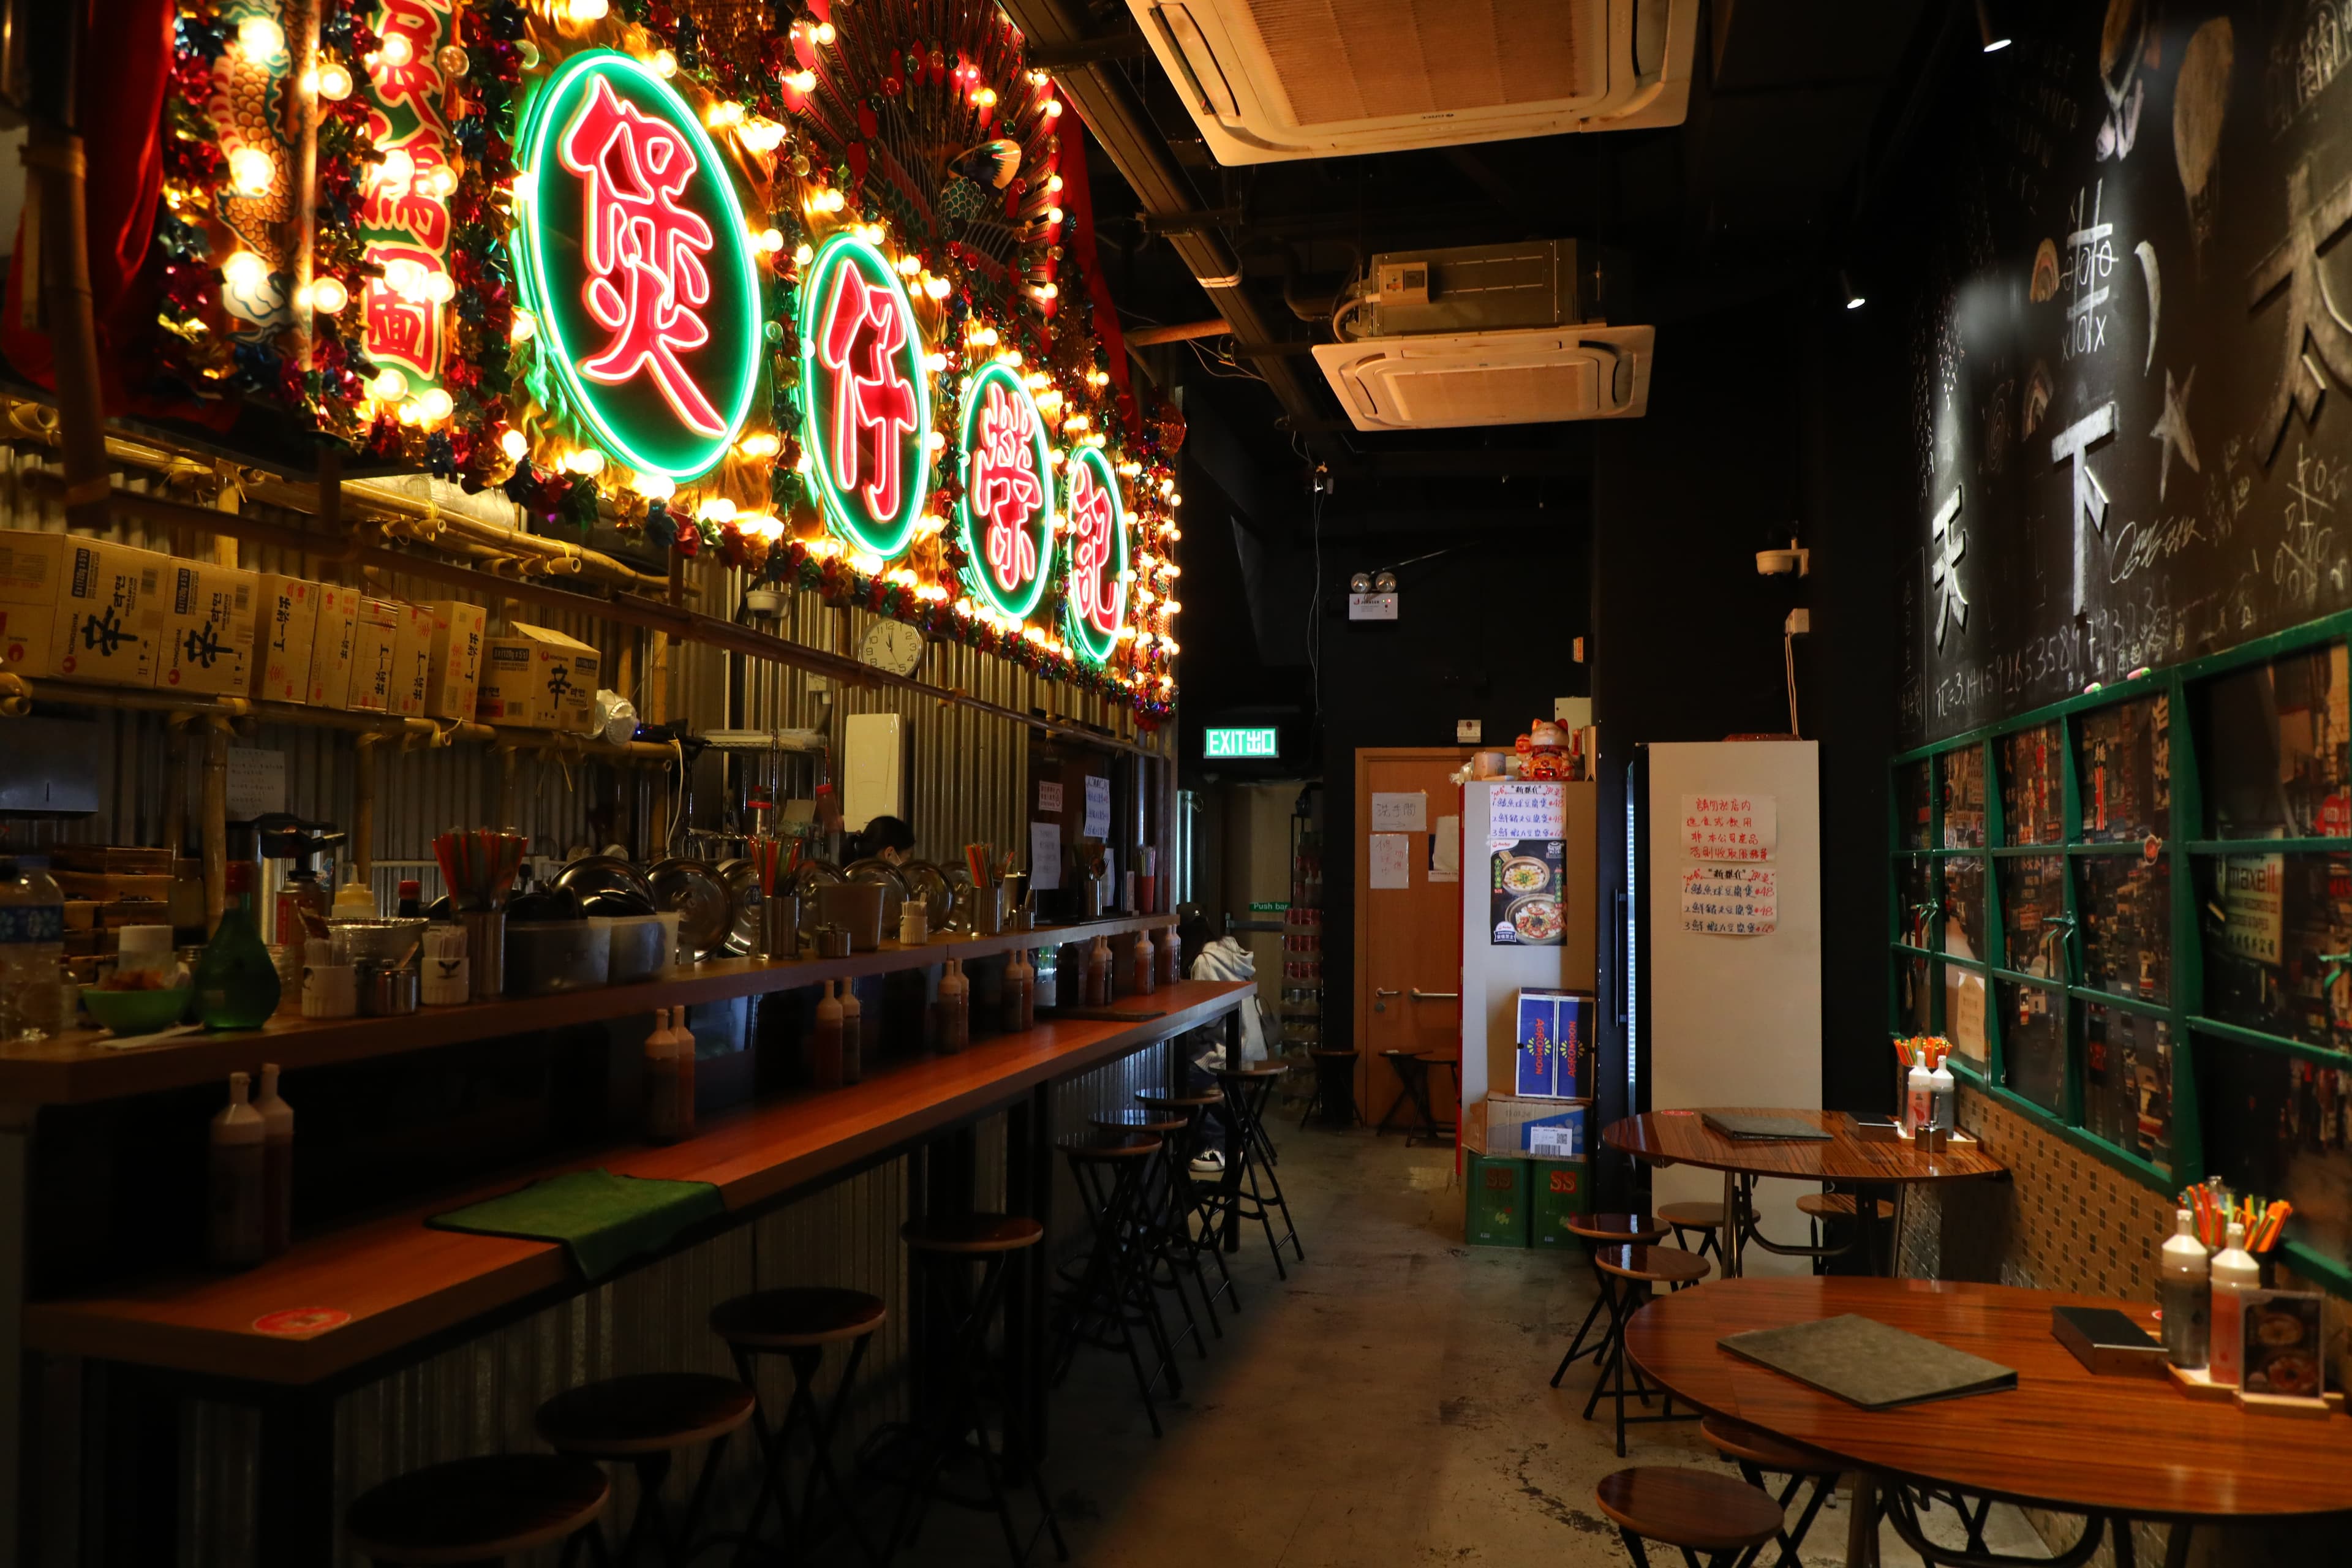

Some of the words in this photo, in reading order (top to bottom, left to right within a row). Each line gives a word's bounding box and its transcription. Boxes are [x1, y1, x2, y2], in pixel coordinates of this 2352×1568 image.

[560, 72, 1116, 638] 煲仔榮記
[113, 575, 126, 608] 라면
[211, 592, 222, 622] 라면
[81, 605, 138, 657] 辛
[184, 620, 233, 668] 辛
[375, 644, 390, 695] 出前一丁
[413, 650, 426, 700] 出前一丁
[465, 632, 480, 683] 出前一丁
[548, 663, 572, 710] 辛
[1210, 731, 1246, 754] EXIT
[1246, 730, 1275, 753] 出口
[1253, 902, 1272, 911] Push
[1275, 902, 1288, 911] bar
[1535, 1017, 1545, 1075] AGROMOON
[1567, 1020, 1578, 1079] AGROMOON
